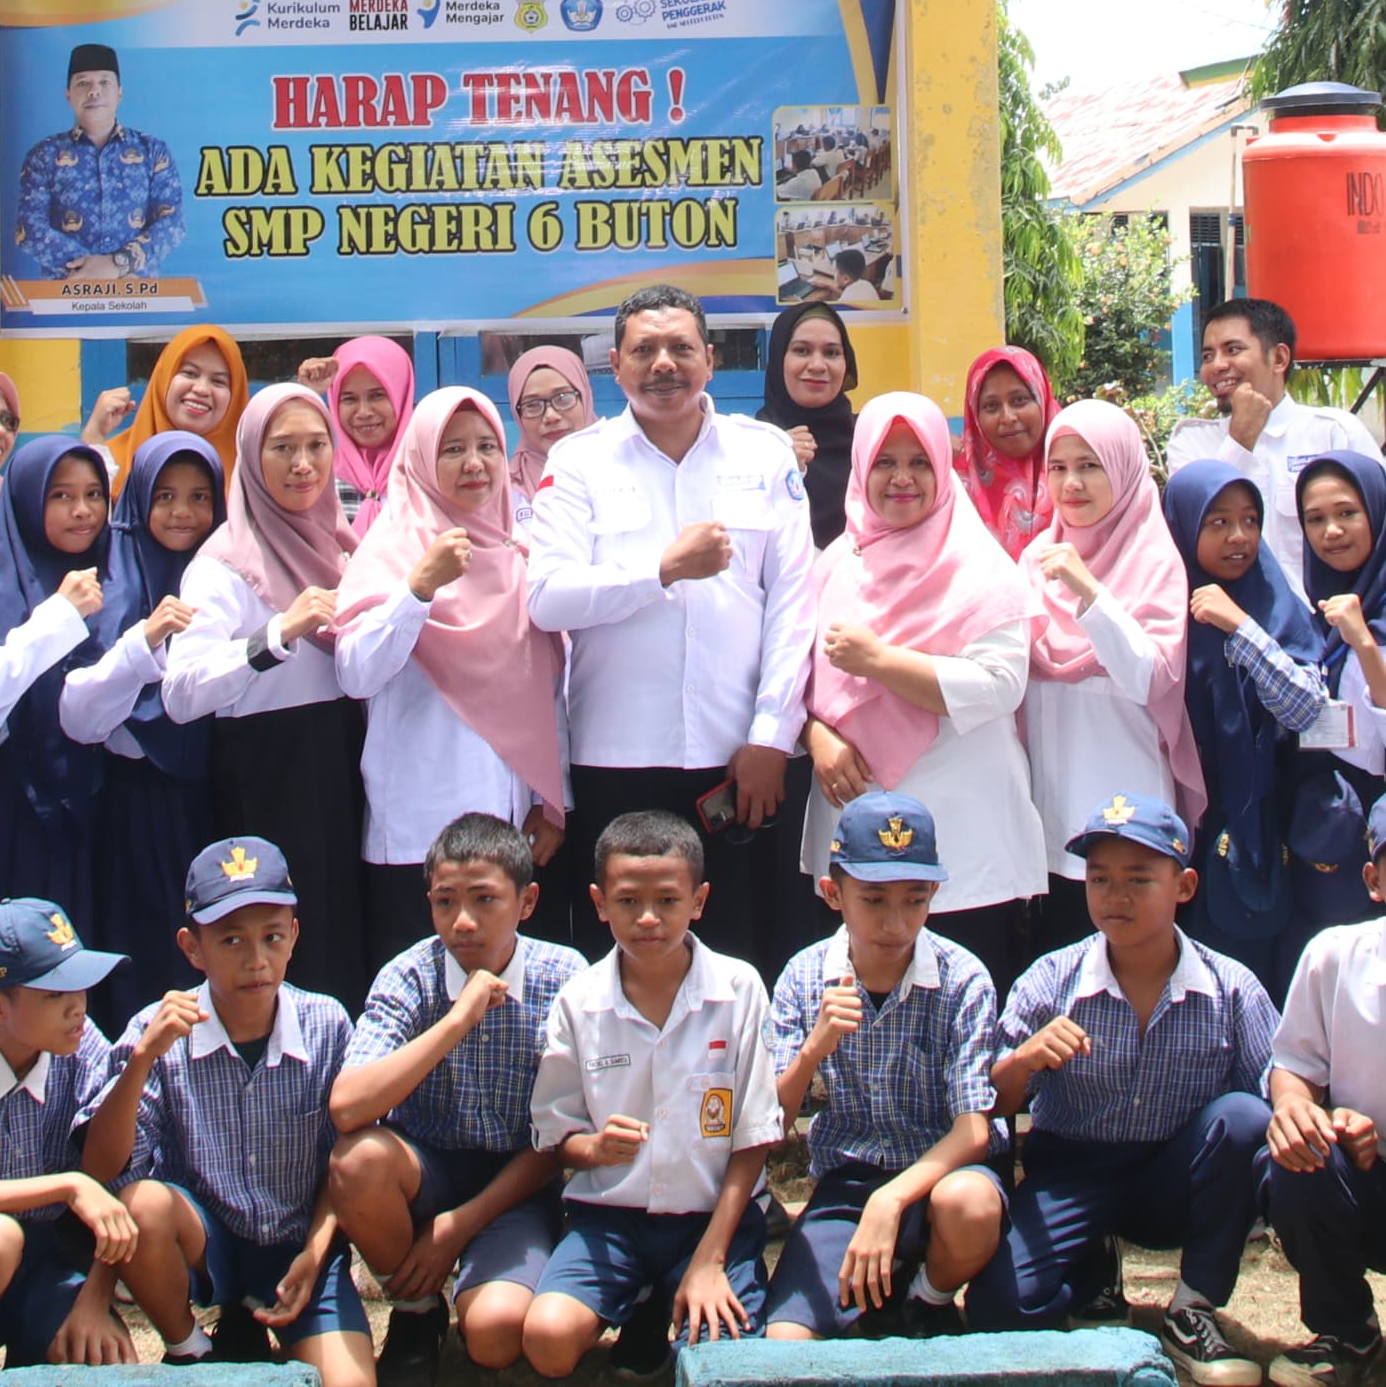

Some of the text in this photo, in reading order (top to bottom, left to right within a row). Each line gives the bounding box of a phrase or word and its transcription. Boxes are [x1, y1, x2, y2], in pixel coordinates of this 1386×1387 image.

[266, 1, 341, 14] Kurikulum
[445, 0, 500, 11] Merdeka
[662, 0, 727, 21] PENGGERAK
[266, 16, 331, 29] Merdeka
[349, 13, 409, 31] BELAJAR
[445, 13, 504, 25] Mengajar
[272, 68, 685, 129] HARAP TENANG !
[195, 136, 763, 196] ADA KEGIATAN ASESMEN
[1347, 172, 1383, 216] INDO
[222, 197, 739, 257] SMP NEGERI 6 BUTON
[125, 283, 158, 294] S.Pd
[71, 299, 147, 312] Kepala Sekolah
